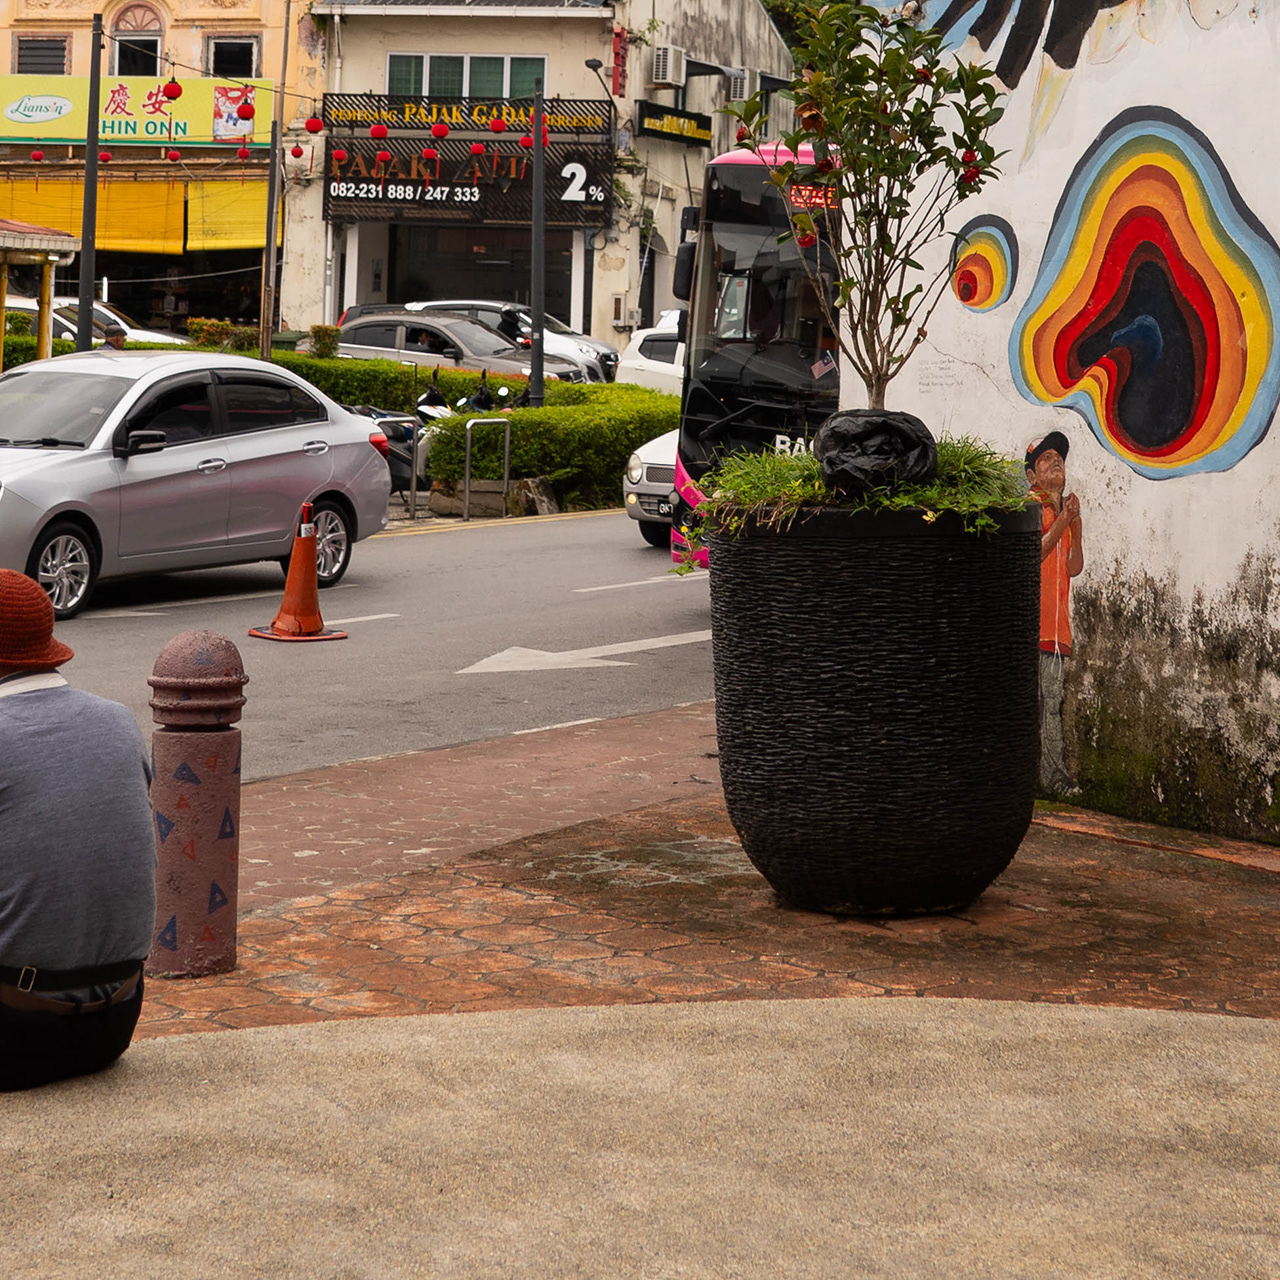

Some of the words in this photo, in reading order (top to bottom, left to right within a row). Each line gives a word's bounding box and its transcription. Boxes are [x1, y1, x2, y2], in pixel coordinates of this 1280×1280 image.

[331, 109, 398, 121] PEMEGANG
[404, 103, 464, 123] PAJAK
[98, 121, 137, 135] HIN
[145, 121, 188, 136] ONN
[330, 152, 432, 179] PAJAK
[330, 182, 383, 198] 082-231
[387, 185, 414, 199] 888
[425, 186, 450, 200] 247
[454, 187, 480, 201] 333
